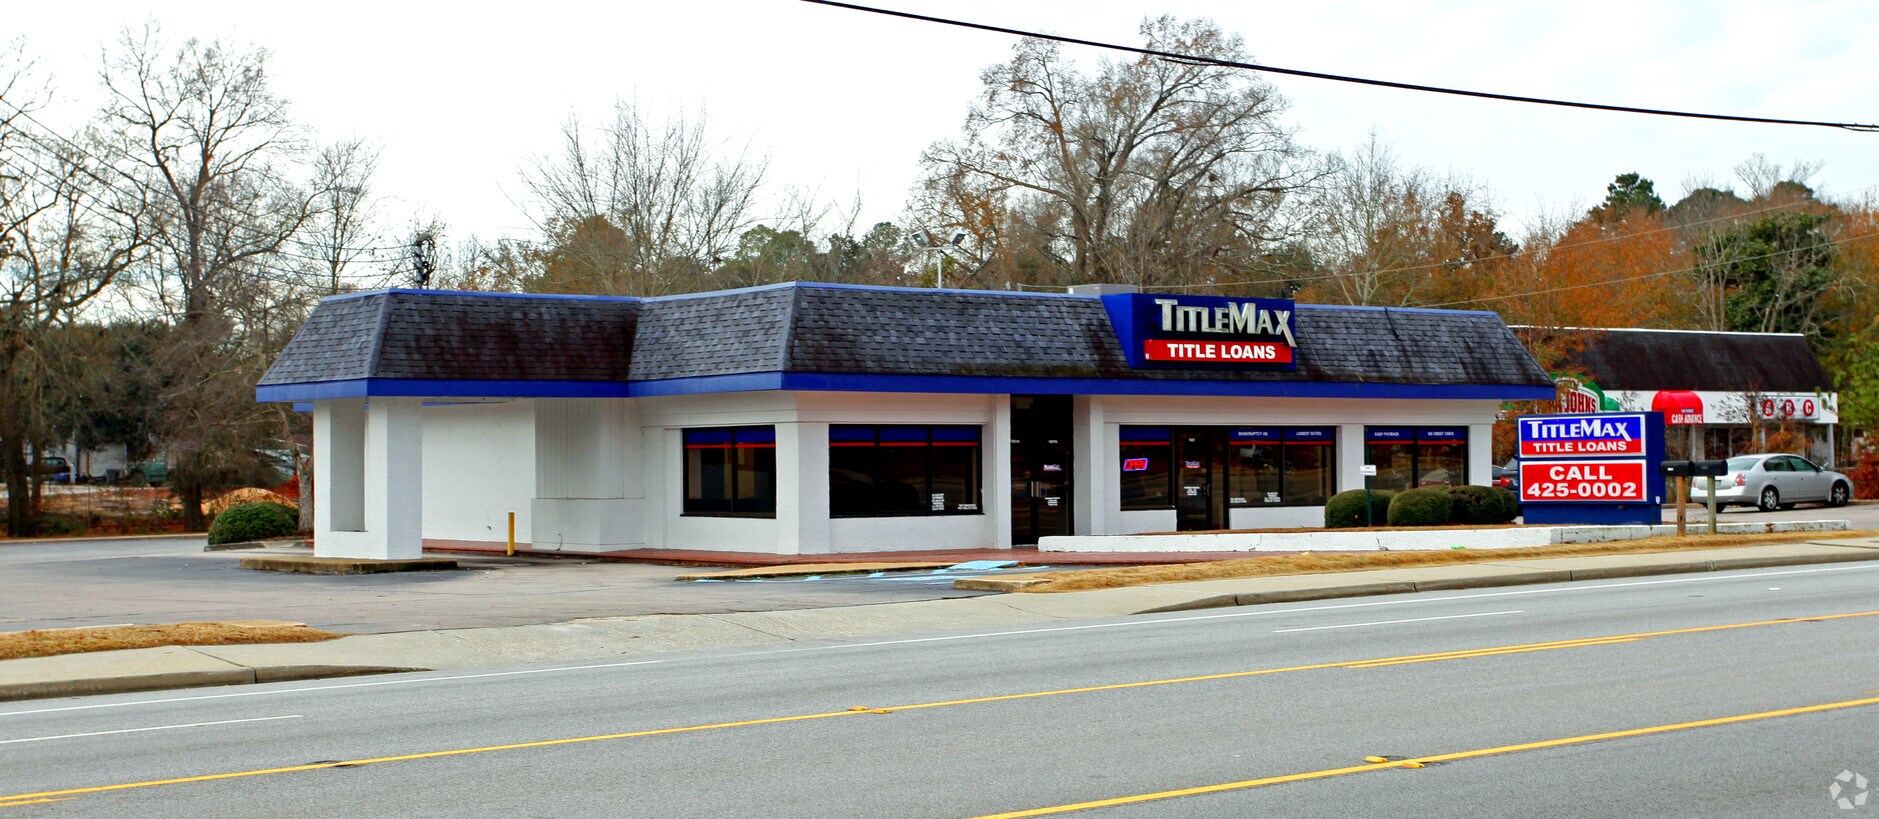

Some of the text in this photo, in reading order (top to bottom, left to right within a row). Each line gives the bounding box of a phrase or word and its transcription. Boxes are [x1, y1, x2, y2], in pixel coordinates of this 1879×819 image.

[1167, 344, 1276, 360] TITLE LOANS
[1564, 391, 1596, 414] JOHNS
[1671, 413, 1703, 424] CASH ADVANCE
[1533, 440, 1627, 453] TITLE LOANS
[1549, 466, 1613, 480] CALL
[1527, 482, 1637, 498] 425-0002
